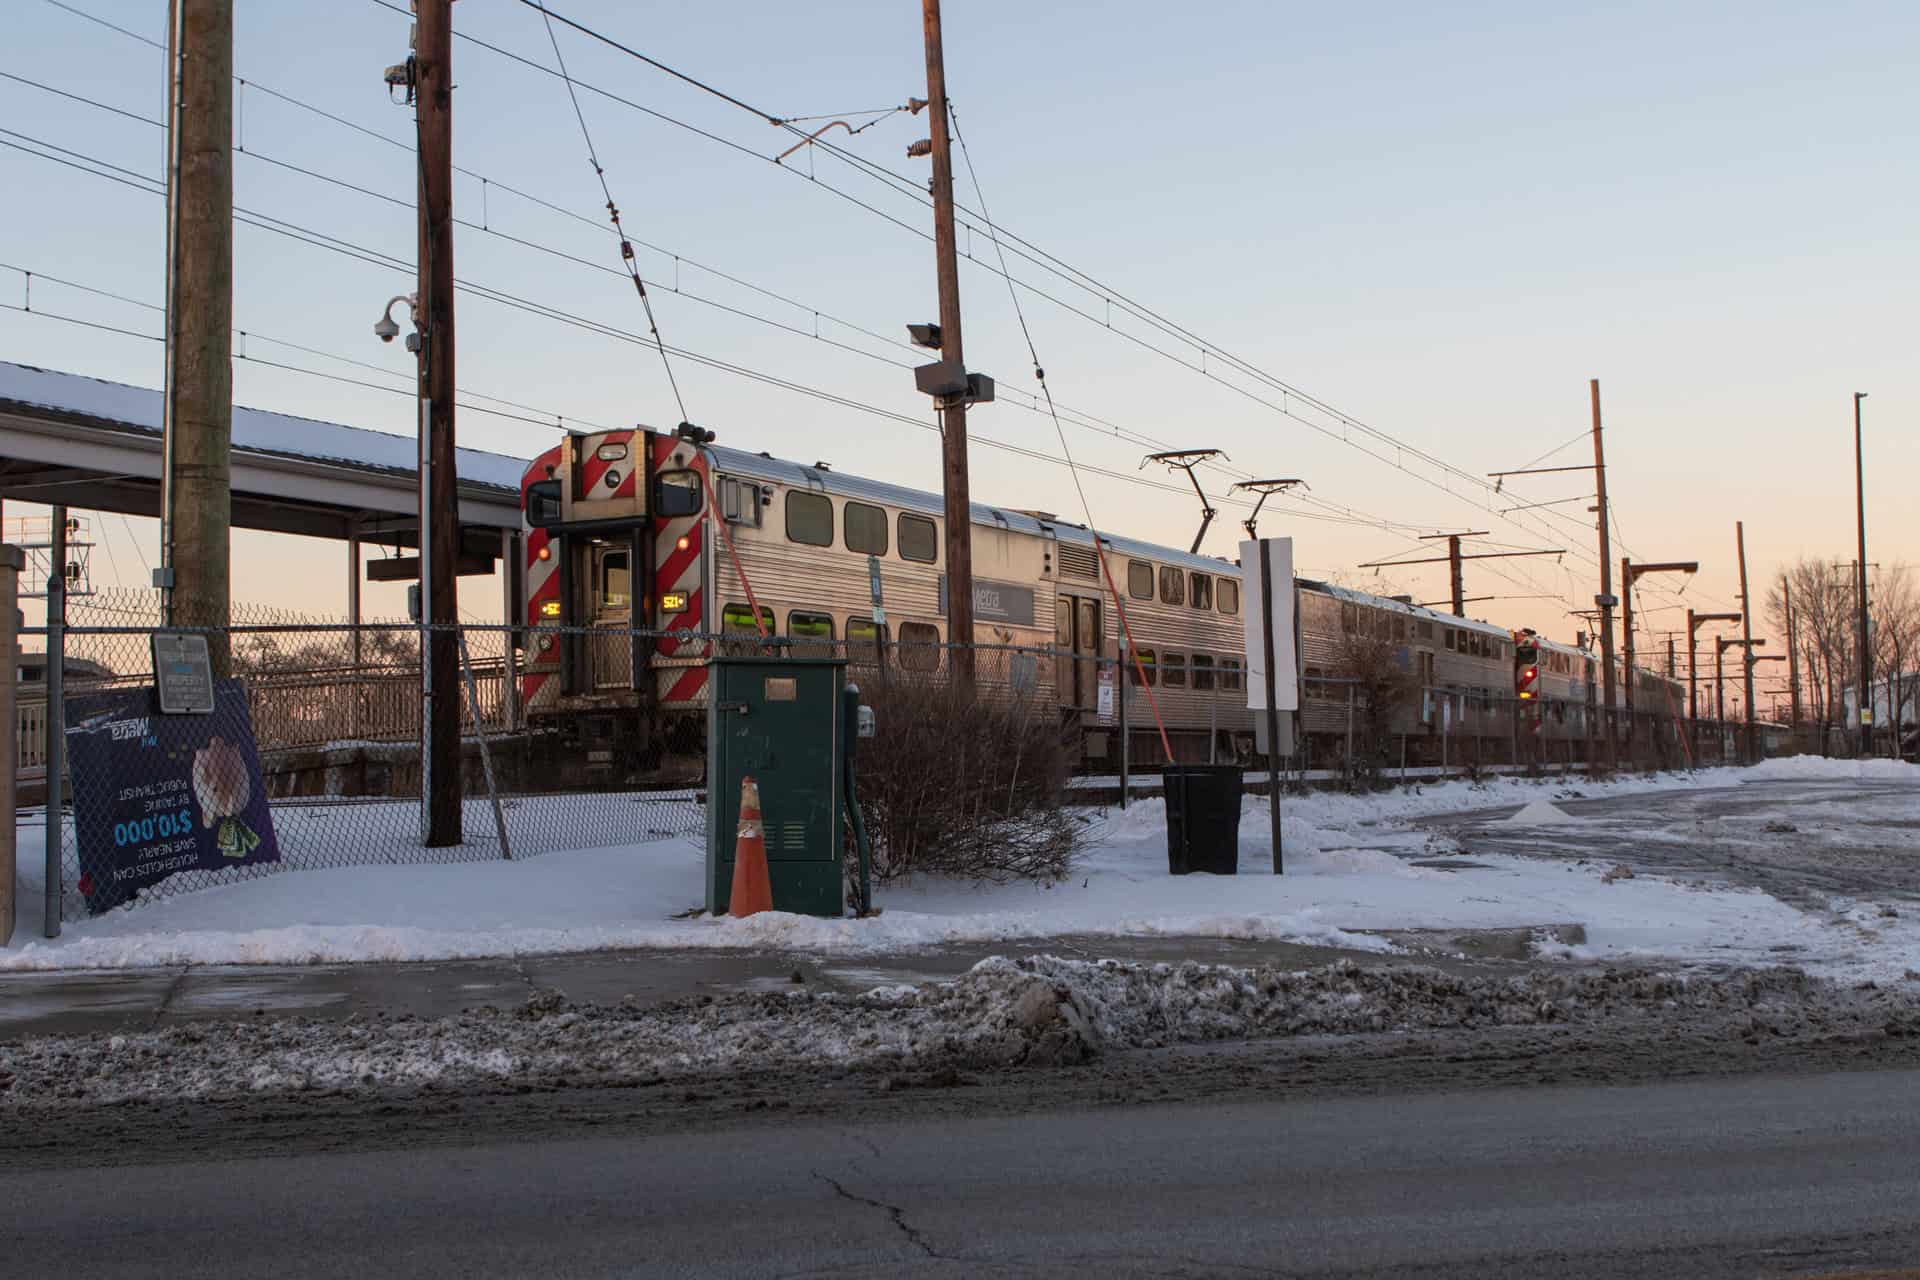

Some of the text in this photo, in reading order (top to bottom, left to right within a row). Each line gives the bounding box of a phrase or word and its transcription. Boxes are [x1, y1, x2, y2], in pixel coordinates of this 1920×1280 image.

[114, 808, 193, 847] $10,000
[138, 837, 196, 860] SAVE NEARLY
[113, 852, 198, 881] HOUSEHOLDS CAN
